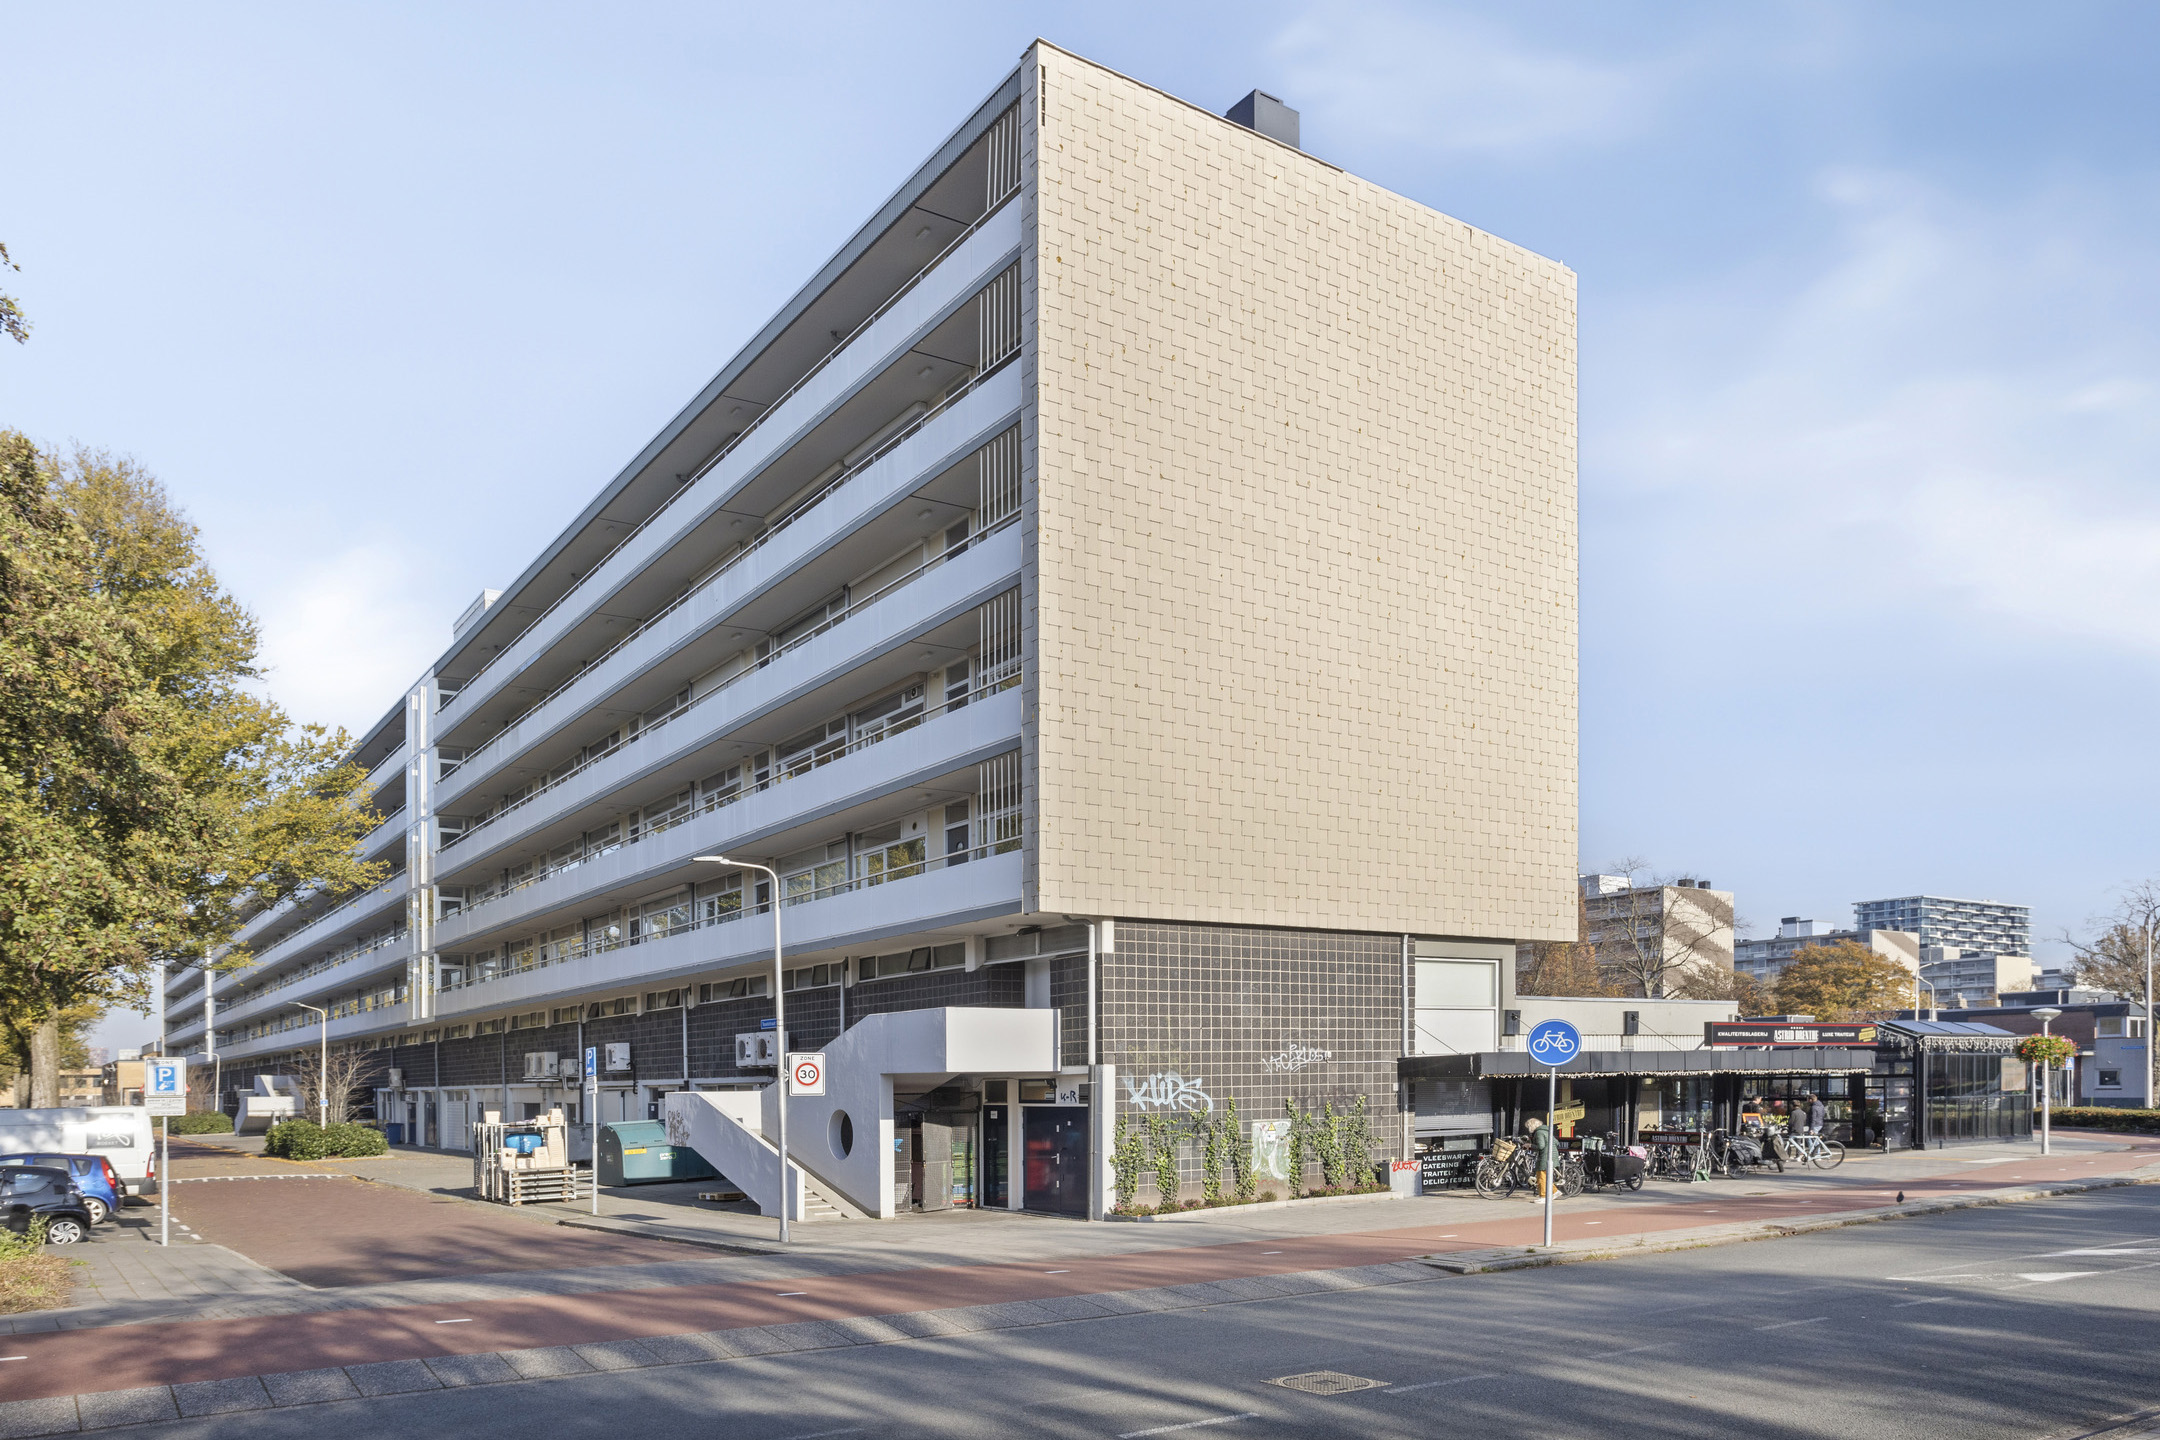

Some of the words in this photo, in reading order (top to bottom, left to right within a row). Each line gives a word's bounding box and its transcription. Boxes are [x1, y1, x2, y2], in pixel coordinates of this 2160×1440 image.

[1774, 1030, 1794, 1041] ASTRID
[159, 1068, 172, 1081] P
[799, 1069, 816, 1079] 30
[1423, 1161, 1459, 1170] CATERING
